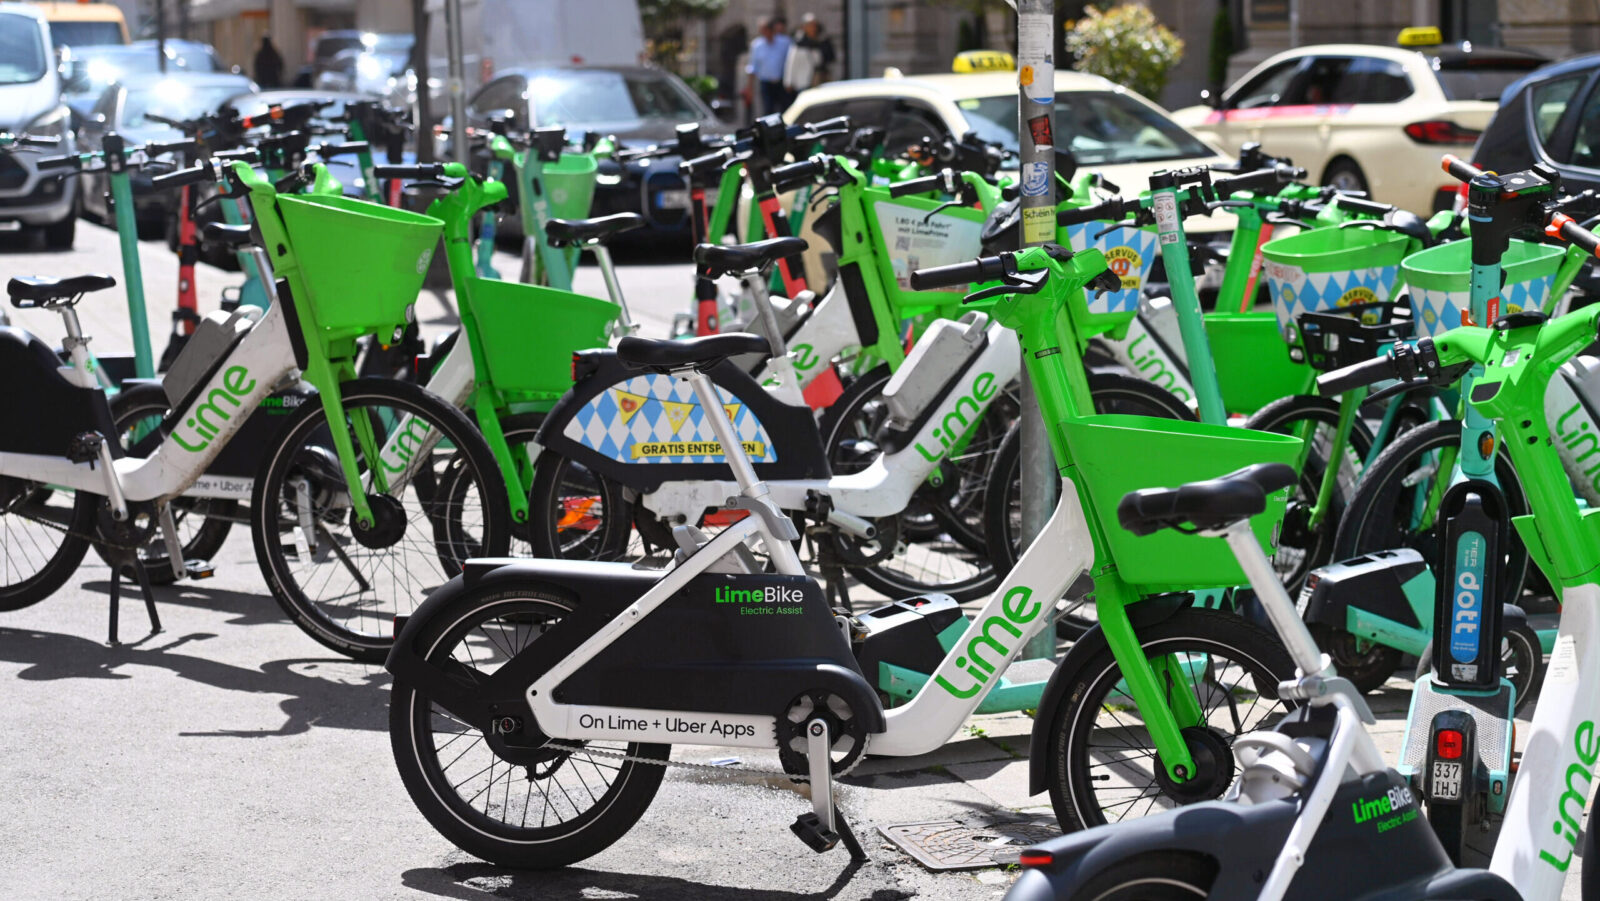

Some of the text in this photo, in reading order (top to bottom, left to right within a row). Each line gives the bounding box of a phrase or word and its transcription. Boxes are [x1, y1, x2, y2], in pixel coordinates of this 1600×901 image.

[1105, 249, 1138, 262] SERVUS
[170, 365, 256, 453] Lime
[914, 371, 998, 463] Lime
[379, 417, 431, 473] Lim
[641, 443, 756, 455] GRATIS ENTSPEN
[220, 480, 243, 492] Uber
[1470, 538, 1479, 567] TIER
[716, 585, 804, 603] LimeBike
[1455, 571, 1480, 634] dott
[740, 606, 803, 615] Electric Assist
[934, 585, 1042, 699] Lime
[579, 713, 755, 739] On Lime + Uber Apps
[1434, 763, 1460, 779] 337
[1352, 785, 1413, 824] LimeBike
[1539, 720, 1600, 872] Lime
